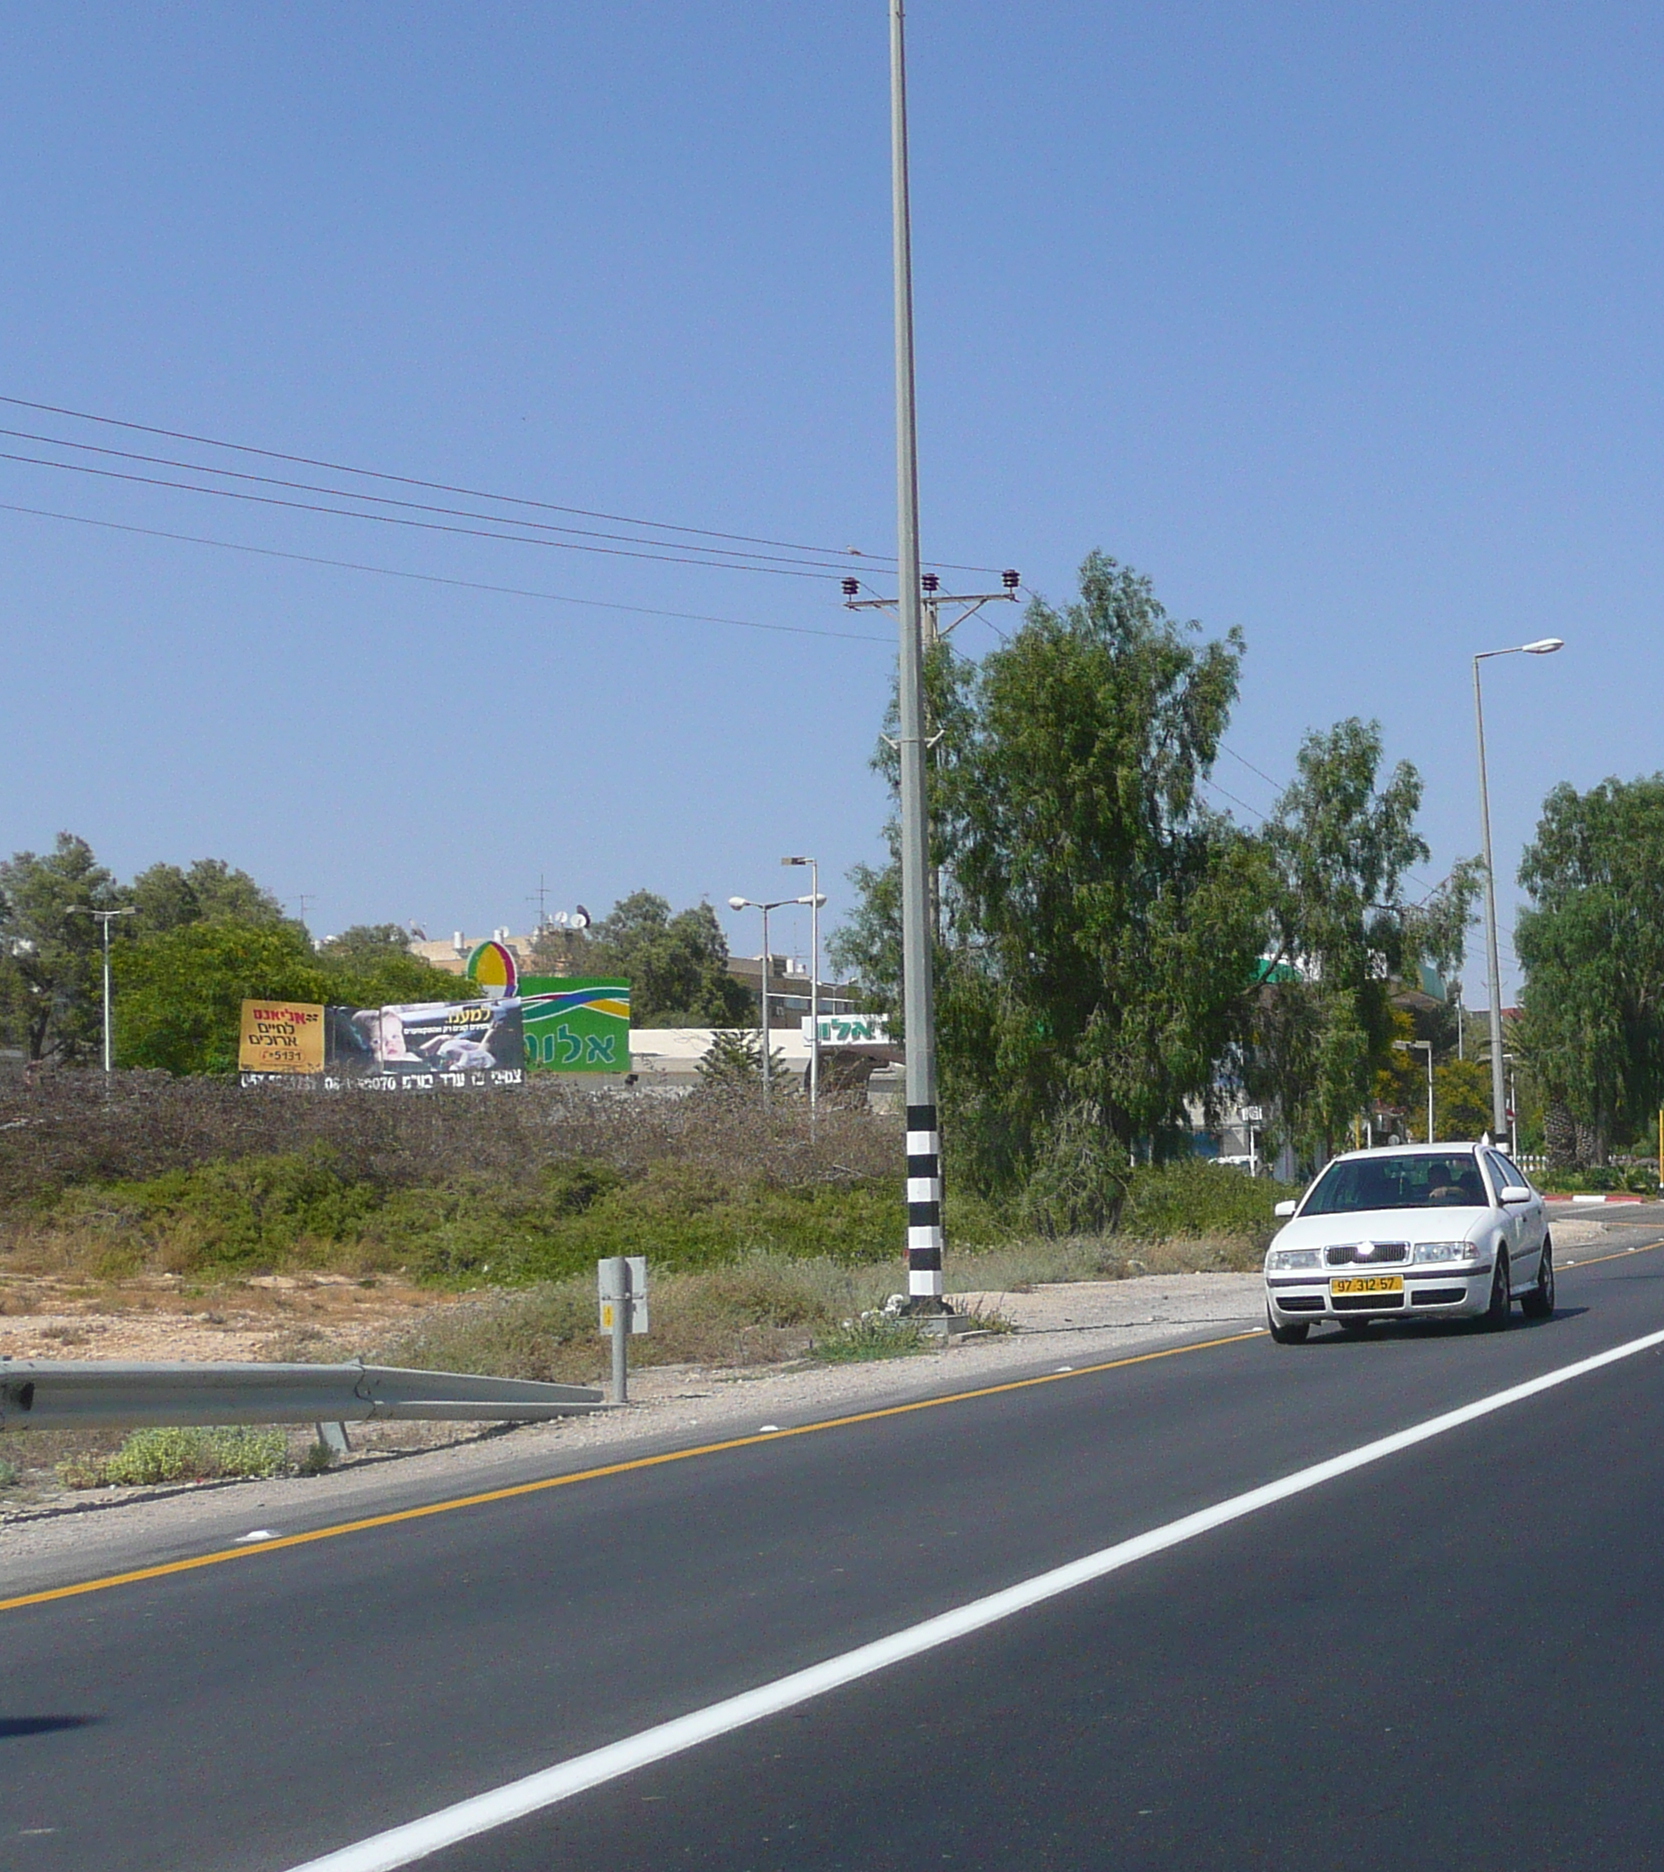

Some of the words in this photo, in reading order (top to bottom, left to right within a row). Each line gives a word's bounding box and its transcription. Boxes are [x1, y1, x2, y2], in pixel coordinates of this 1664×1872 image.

[253, 1008, 307, 1025] אליאנס
[257, 1021, 296, 1035] לחיים
[248, 1034, 299, 1047] ארוכים
